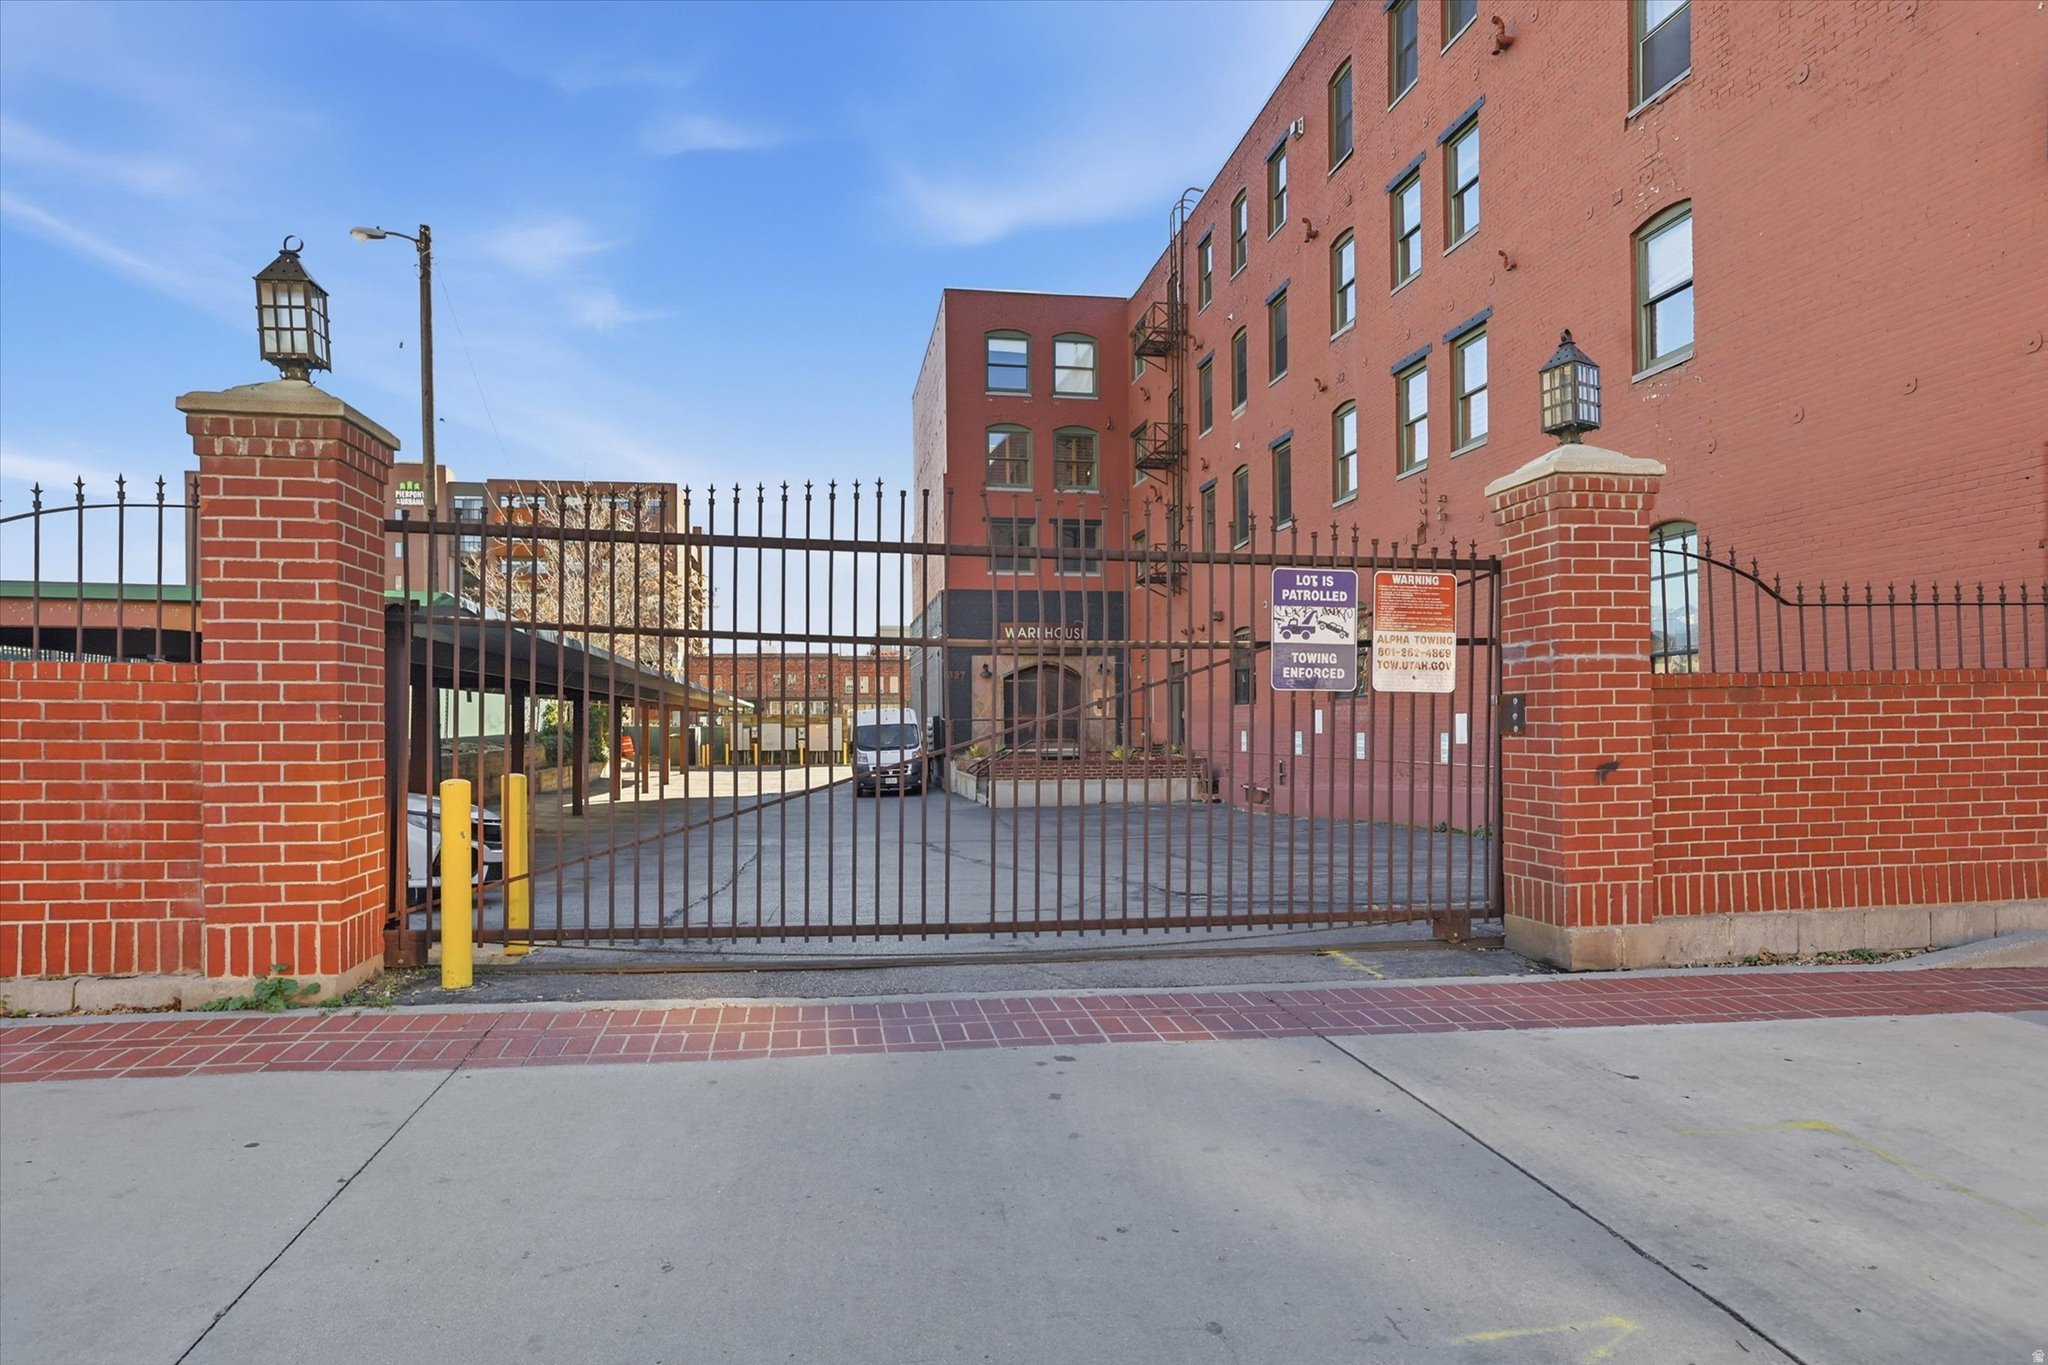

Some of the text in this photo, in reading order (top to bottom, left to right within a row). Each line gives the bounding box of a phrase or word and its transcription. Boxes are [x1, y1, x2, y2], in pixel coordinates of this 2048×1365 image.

[1296, 575, 1334, 587] LOT IS
[1392, 574, 1440, 585] WARNING
[1282, 589, 1348, 602] PATROLLED
[1377, 634, 1453, 645] ALPHA TOWING
[1291, 652, 1337, 664] TOWING
[1377, 660, 1452, 671] TOW.UTAH.GOV
[1283, 667, 1345, 679] ENFORCED
